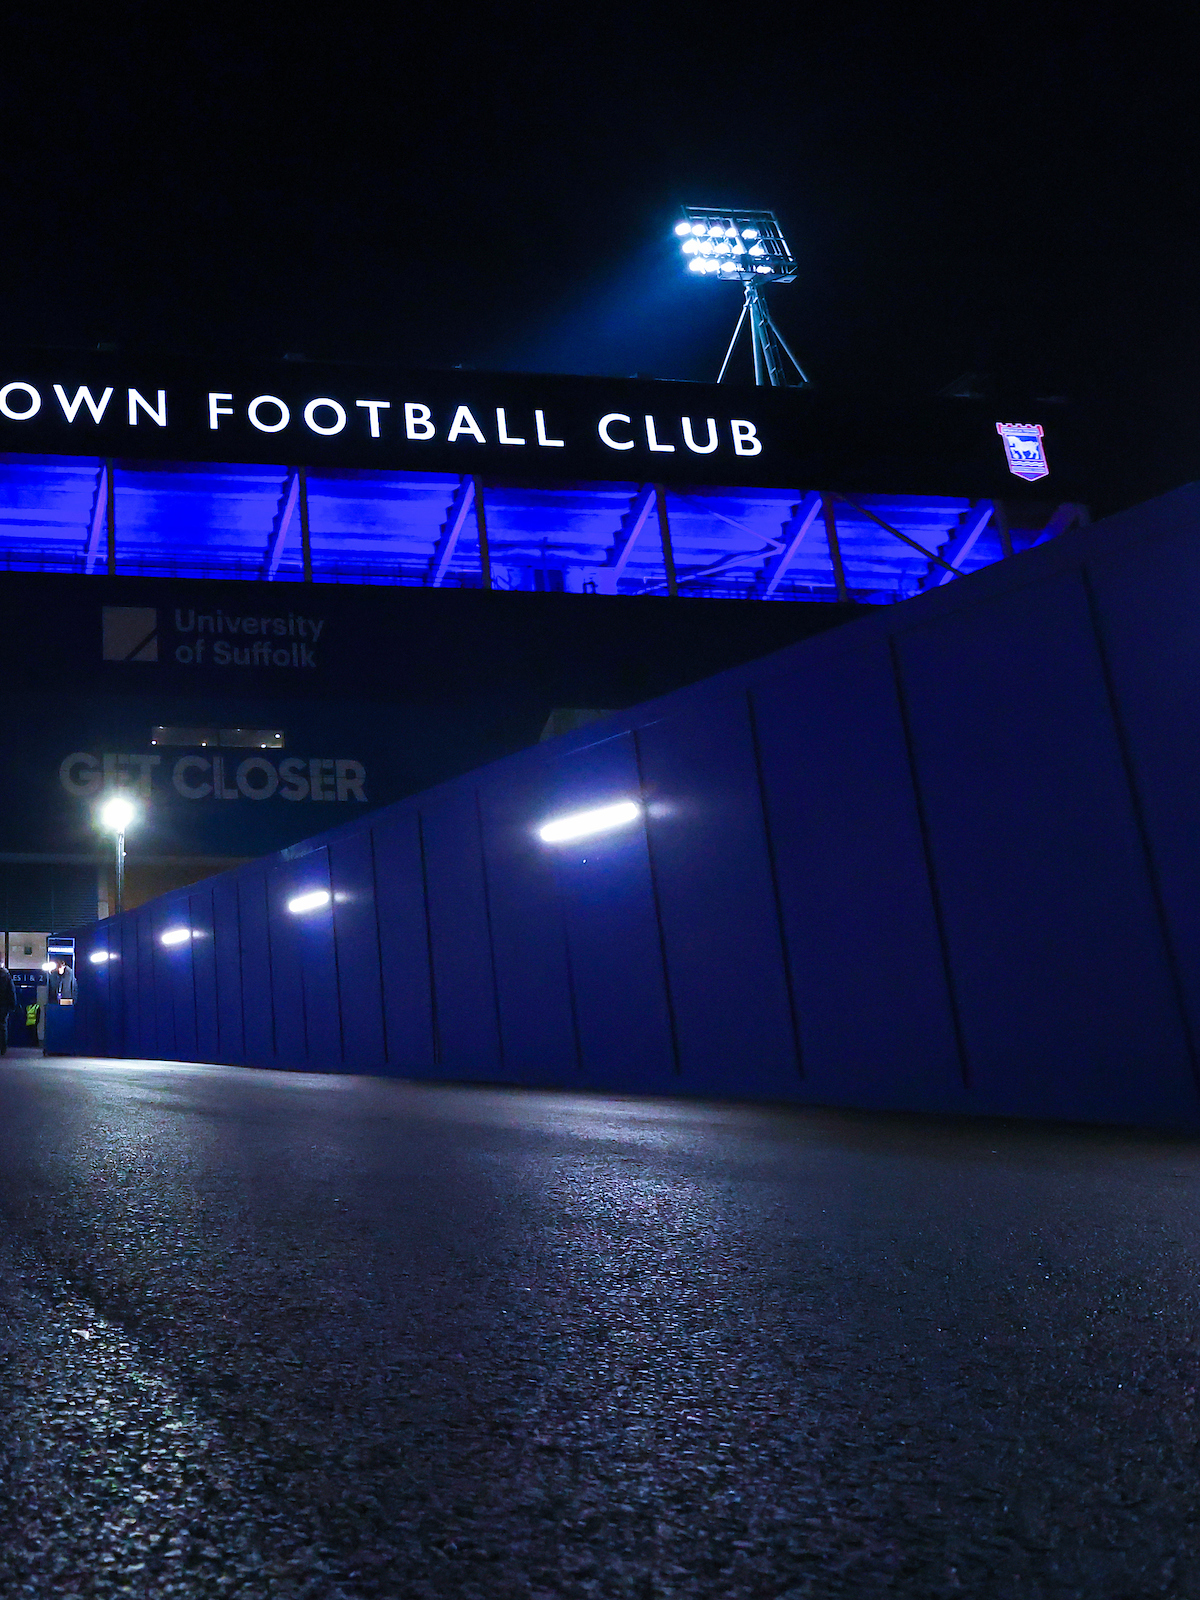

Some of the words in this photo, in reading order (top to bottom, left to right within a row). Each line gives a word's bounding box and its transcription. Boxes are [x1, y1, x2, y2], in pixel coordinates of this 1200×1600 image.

[208, 392, 565, 447] FOOTBALL
[598, 413, 762, 456] CLUB
[175, 608, 324, 642] University
[174, 639, 206, 664] of
[212, 640, 317, 667] Suffolk
[59, 752, 161, 798] GET
[172, 755, 369, 802] CLOSER
